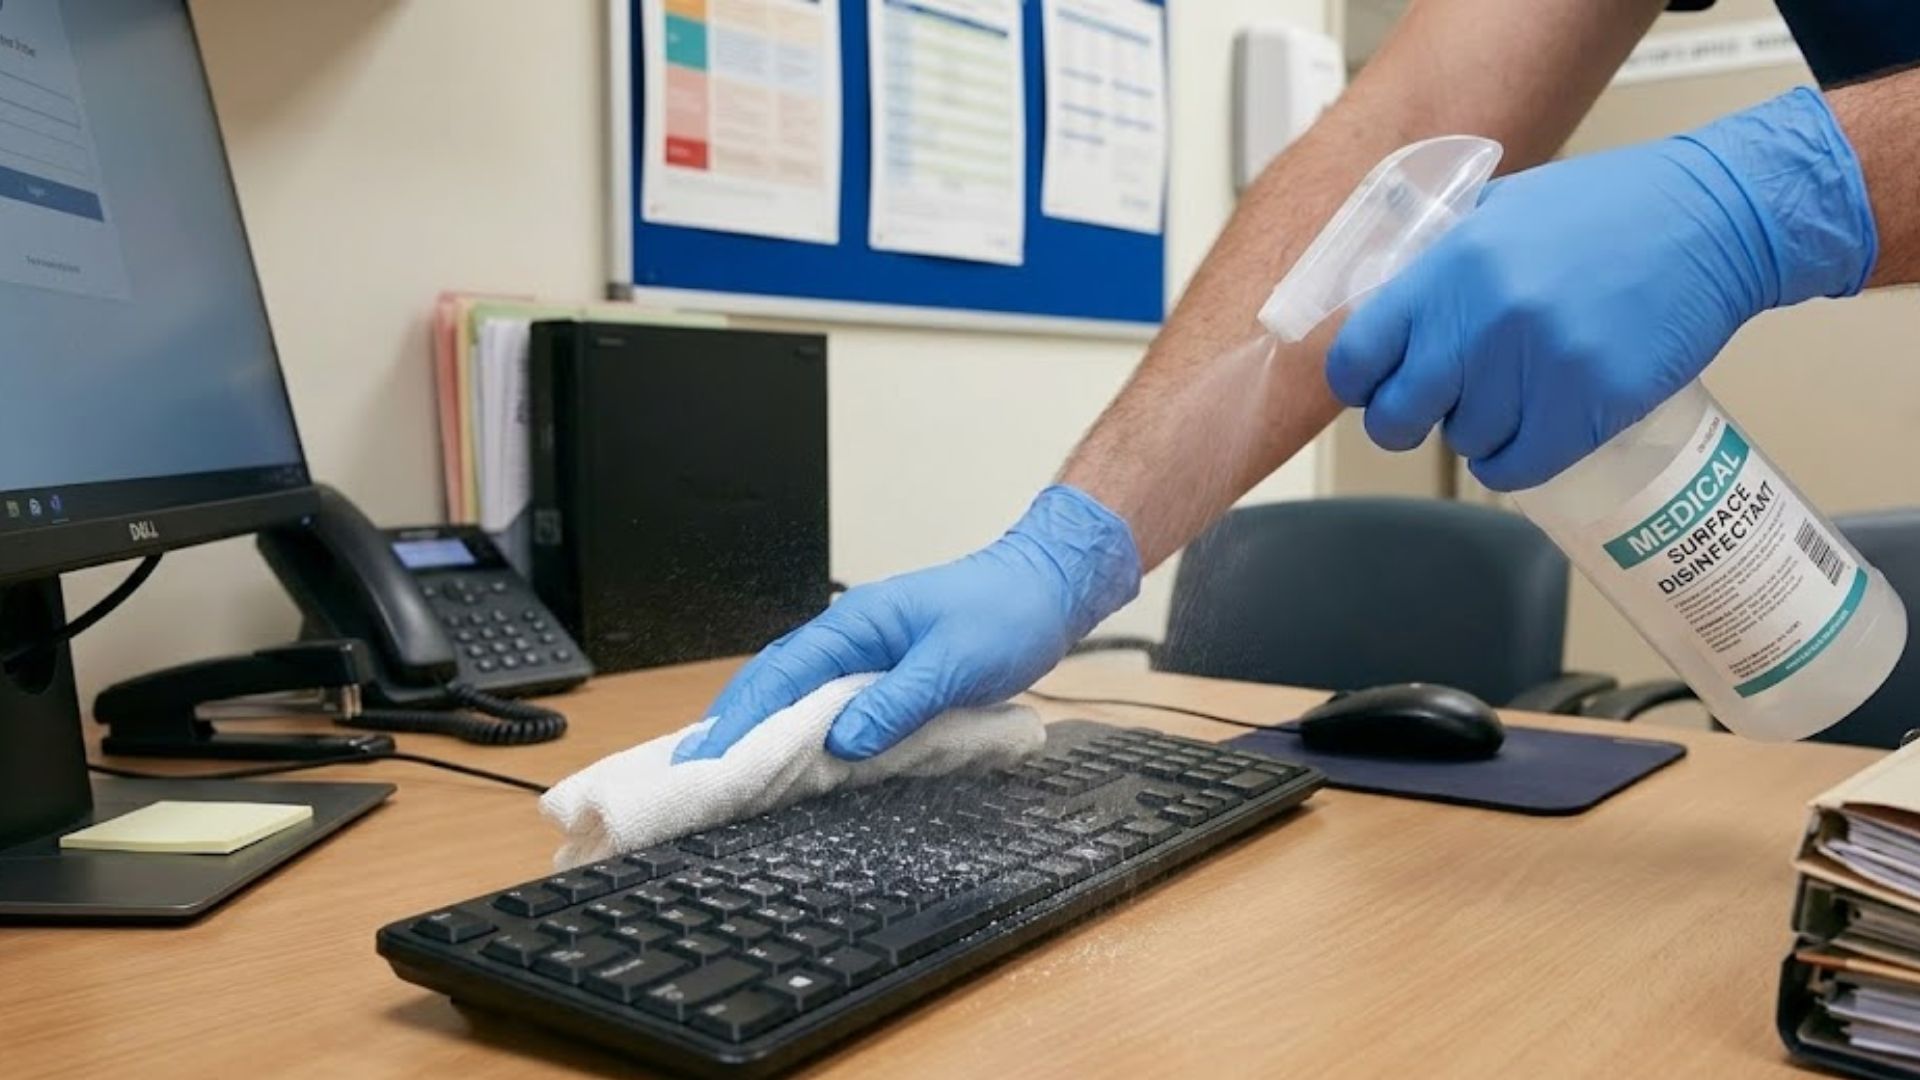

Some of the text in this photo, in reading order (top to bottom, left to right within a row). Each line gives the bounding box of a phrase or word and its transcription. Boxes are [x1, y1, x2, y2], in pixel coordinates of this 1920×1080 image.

[129, 520, 159, 541] DELL
[1628, 450, 1741, 557] MEDICAL
[1657, 480, 1775, 595] DISINFECTANT
[1667, 482, 1751, 565] SURFACE
